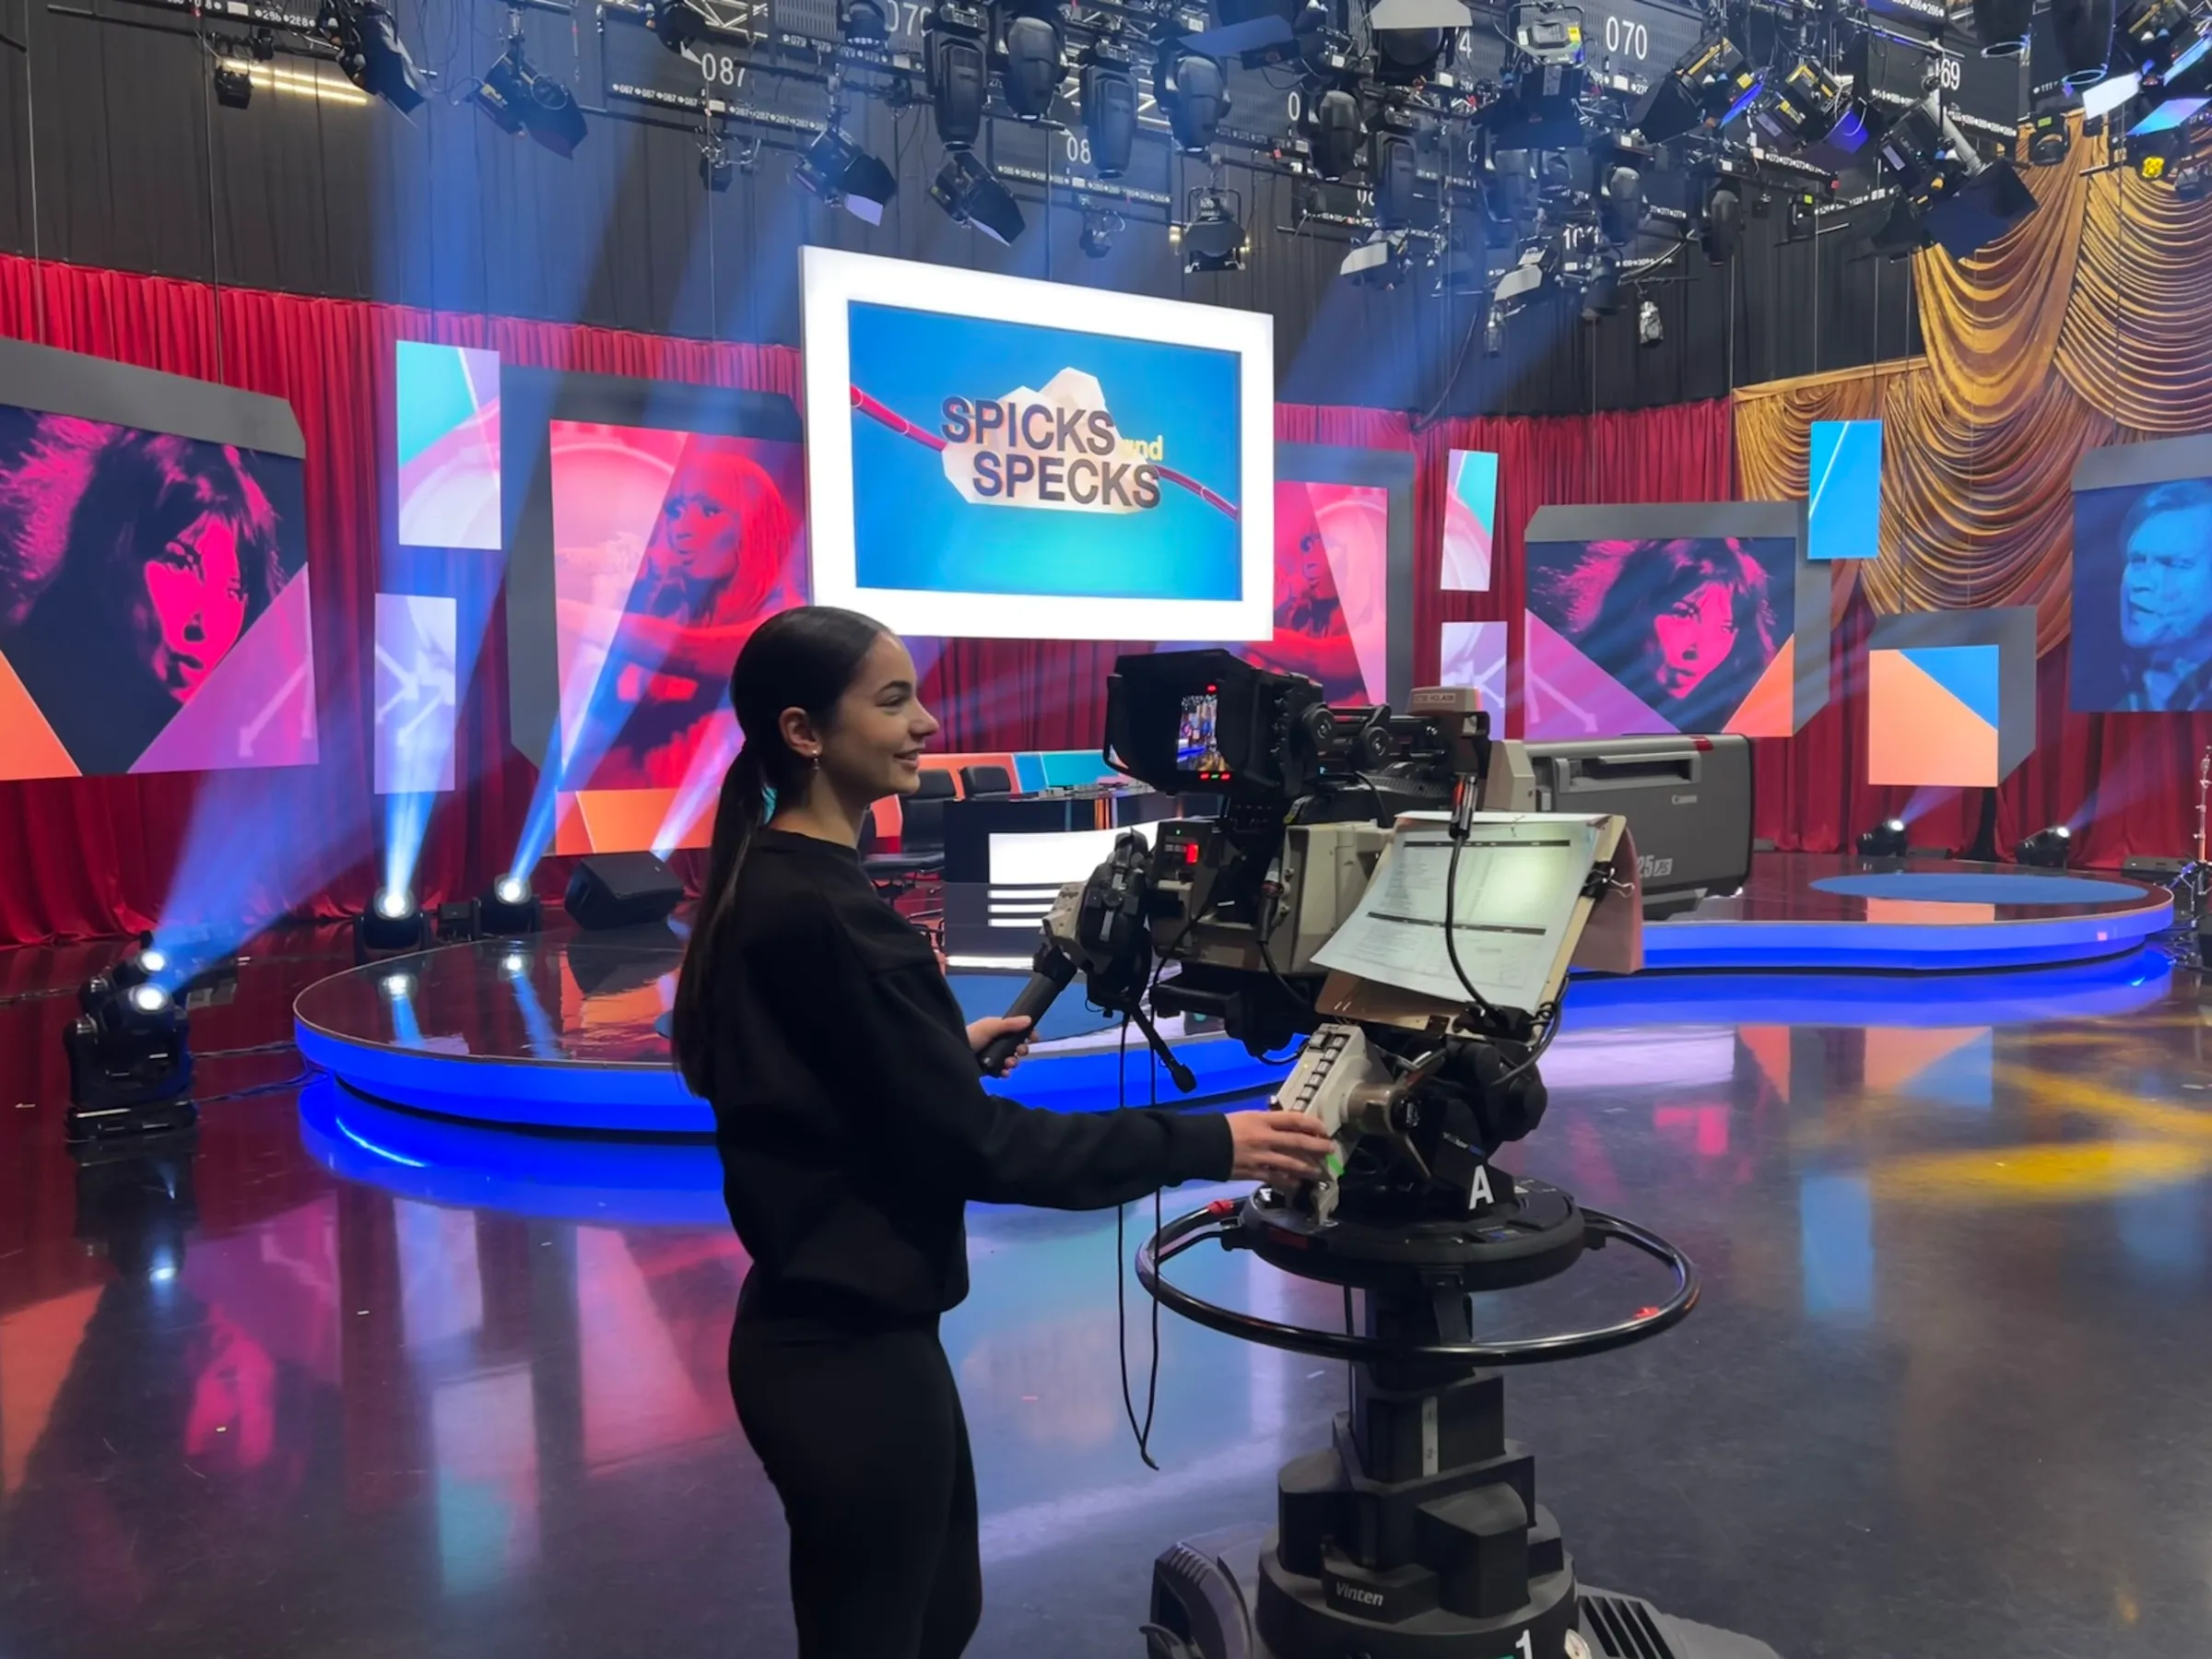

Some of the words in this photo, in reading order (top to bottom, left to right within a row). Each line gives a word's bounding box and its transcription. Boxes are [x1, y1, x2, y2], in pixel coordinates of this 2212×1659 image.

[1606, 16, 1648, 60] 070
[1936, 57, 1961, 90] 69
[1066, 136, 1092, 164] 08
[941, 395, 1116, 455] SPICKS
[972, 451, 1161, 510] SPECKS
[1468, 1164, 1495, 1210] A
[1336, 1582, 1383, 1606] Vinten
